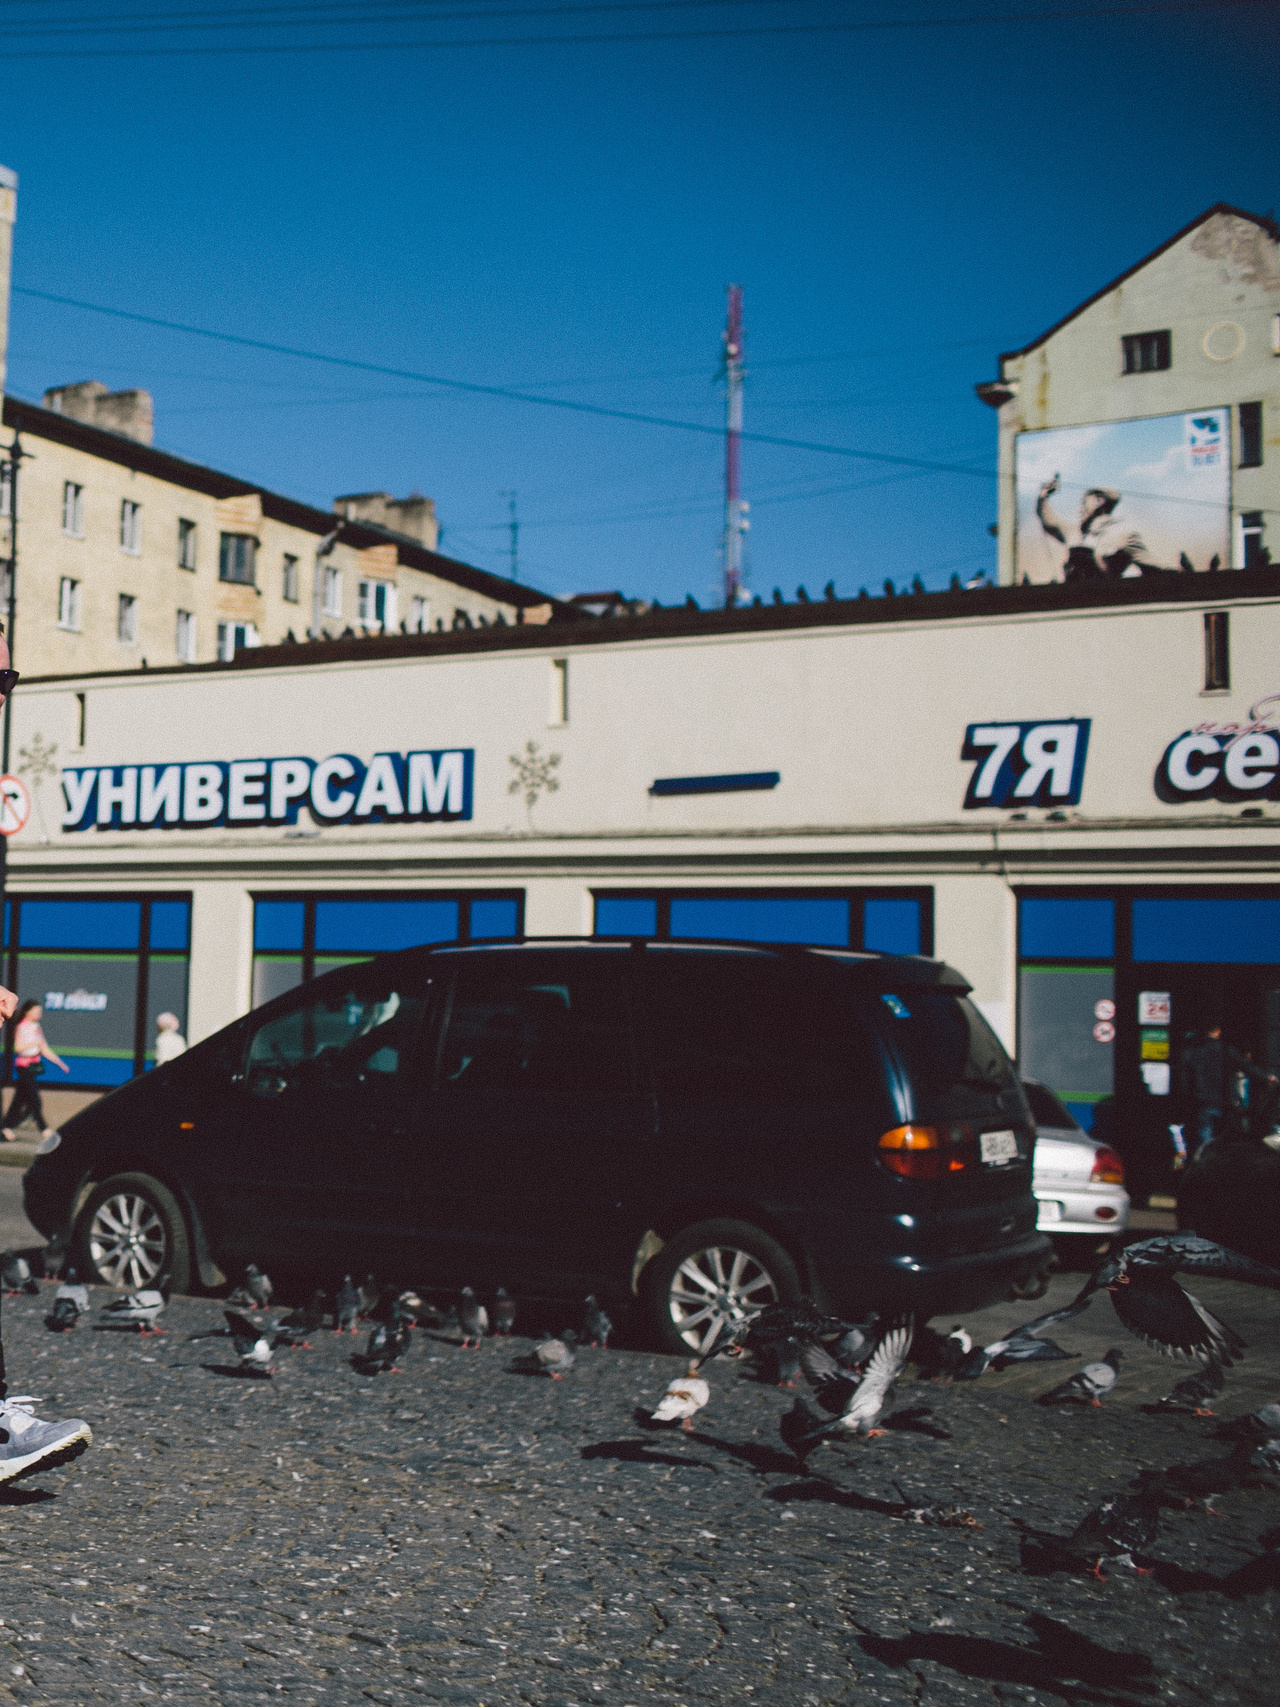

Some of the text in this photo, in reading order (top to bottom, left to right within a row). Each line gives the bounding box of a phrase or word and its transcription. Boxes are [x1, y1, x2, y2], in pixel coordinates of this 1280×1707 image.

[62, 749, 471, 829] УНИВЕРСАМ
[966, 721, 1280, 804] 7Я се
